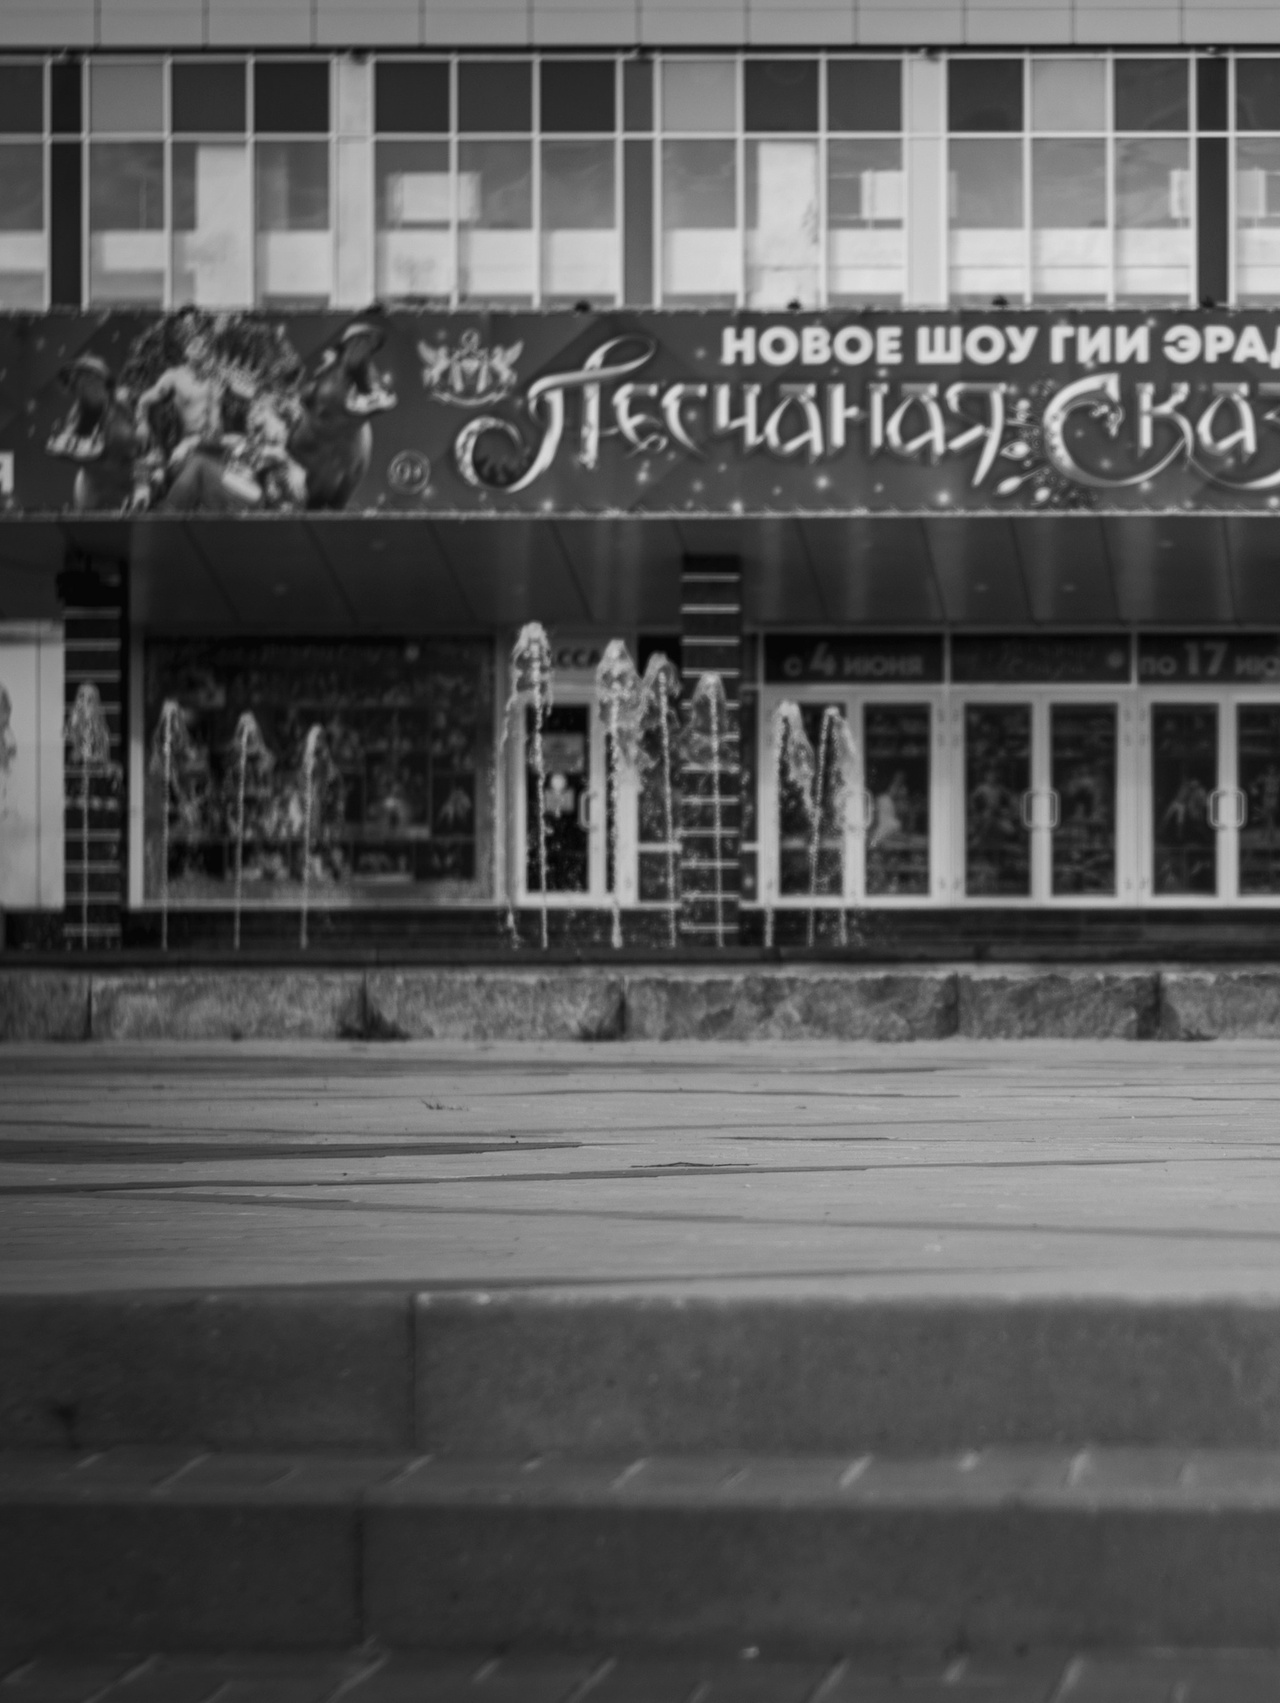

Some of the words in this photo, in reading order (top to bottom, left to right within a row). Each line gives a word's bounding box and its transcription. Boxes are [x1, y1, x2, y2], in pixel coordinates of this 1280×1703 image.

[721, 326, 902, 365] НОВОЕ
[917, 326, 1038, 364] ШОУ
[1051, 327, 1149, 364] ГИИ
[809, 642, 837, 677] 4
[1185, 642, 1228, 676] 17
